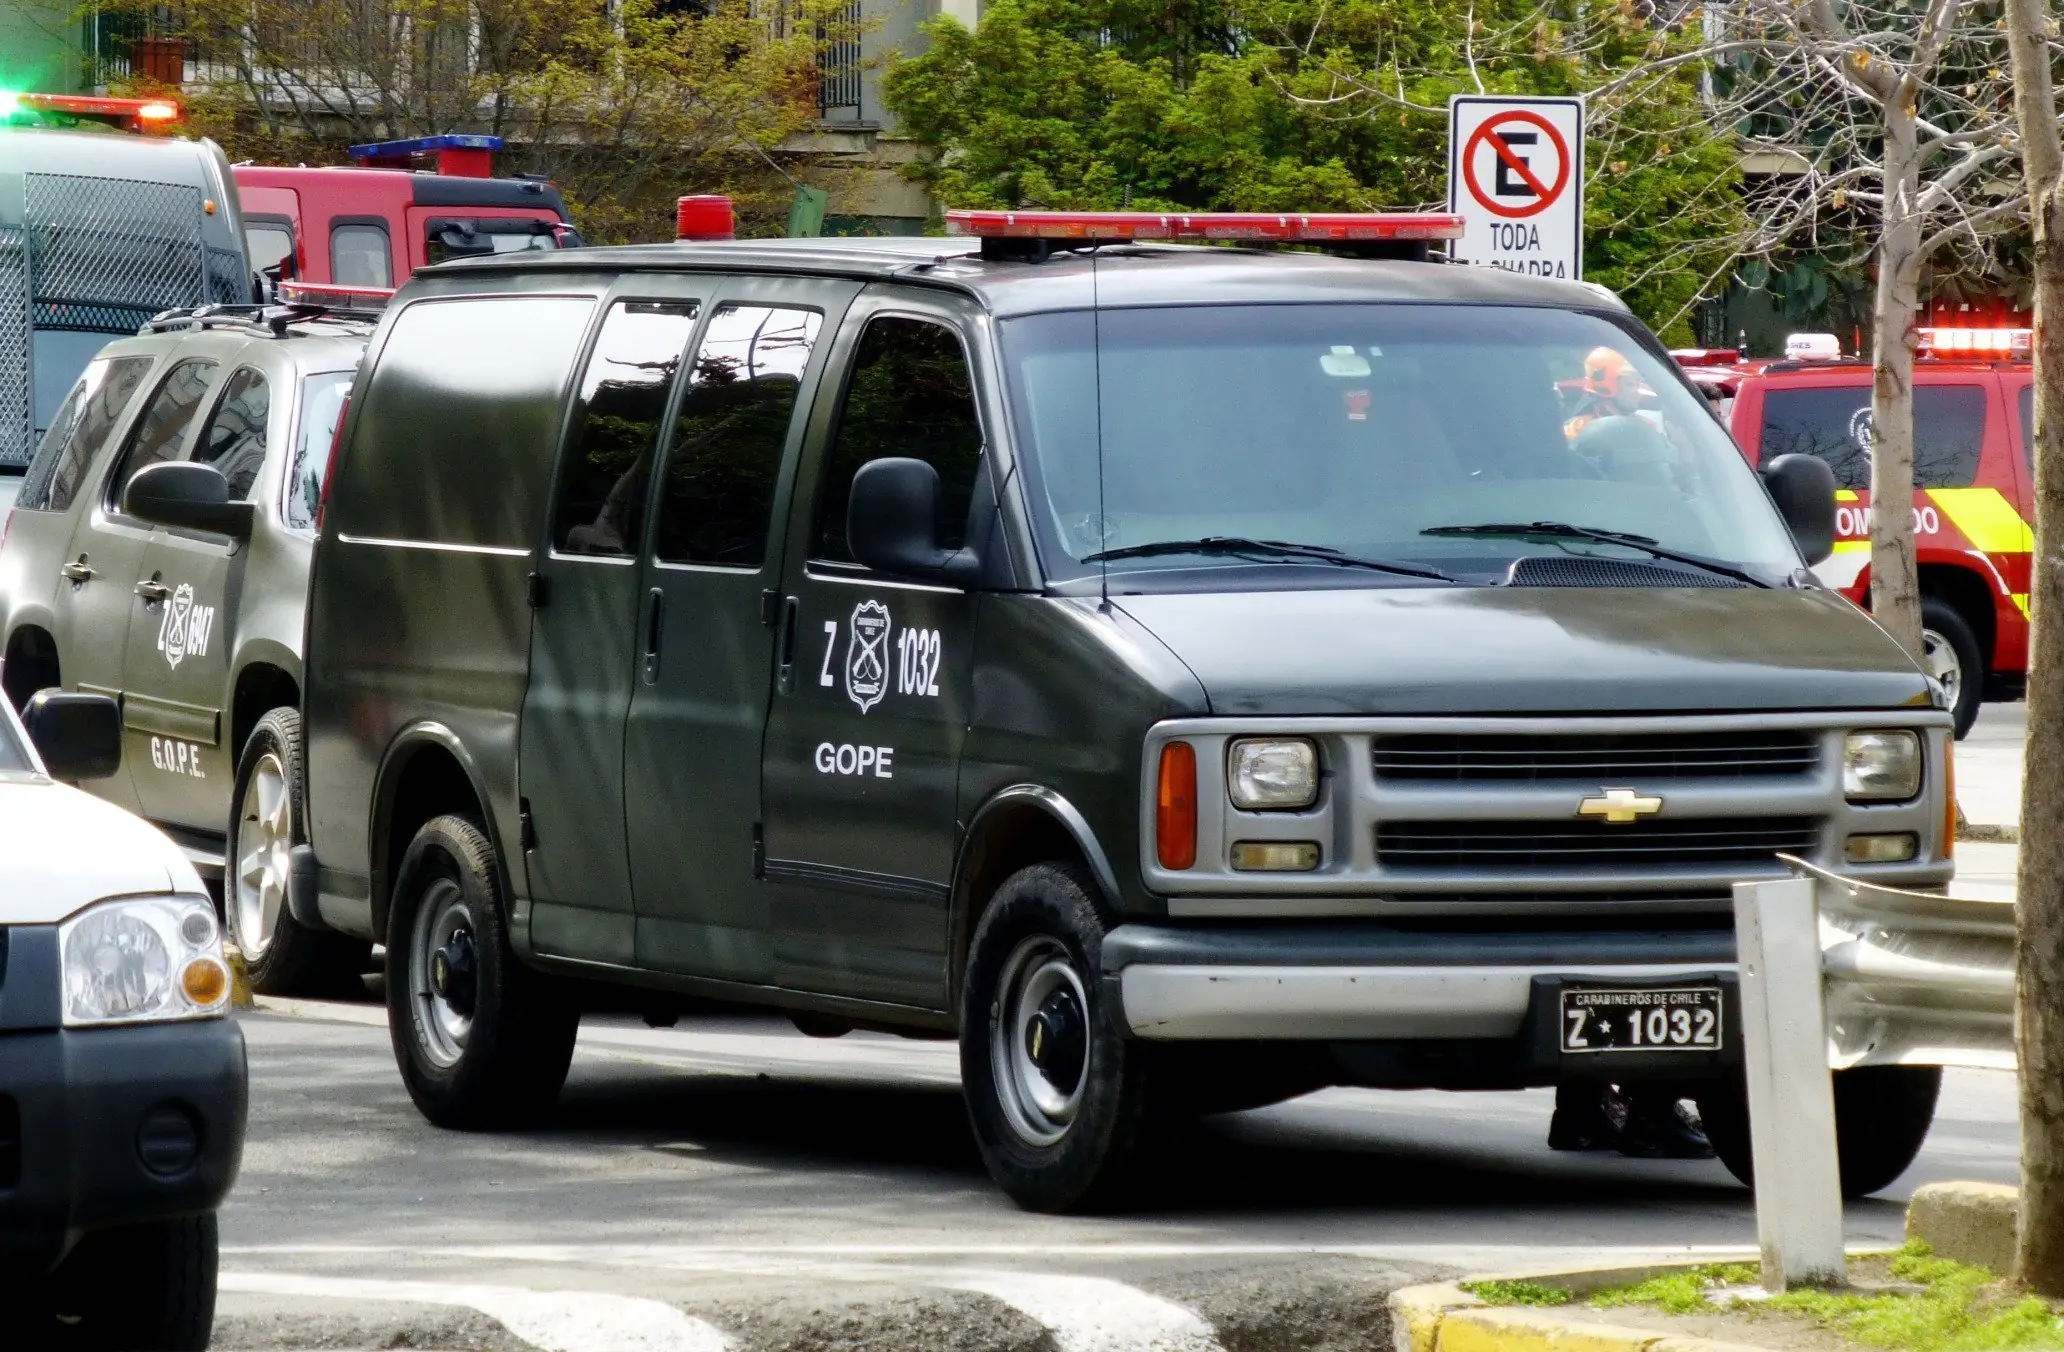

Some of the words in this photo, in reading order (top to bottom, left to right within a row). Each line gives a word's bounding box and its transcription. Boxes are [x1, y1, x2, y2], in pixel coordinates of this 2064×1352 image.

[1490, 223, 1541, 251] TODA
[157, 600, 171, 651] Z
[820, 621, 837, 687] Z
[898, 627, 941, 697] 1032
[151, 736, 206, 779] G.O.P.E.
[815, 742, 894, 778] GOPE
[1576, 994, 1651, 1006] CARABINEROS
[1653, 994, 1668, 1005] DE
[1669, 993, 1701, 1005] CHILE
[1567, 1010, 1588, 1047] Z
[1628, 1009, 1715, 1045] 1032
